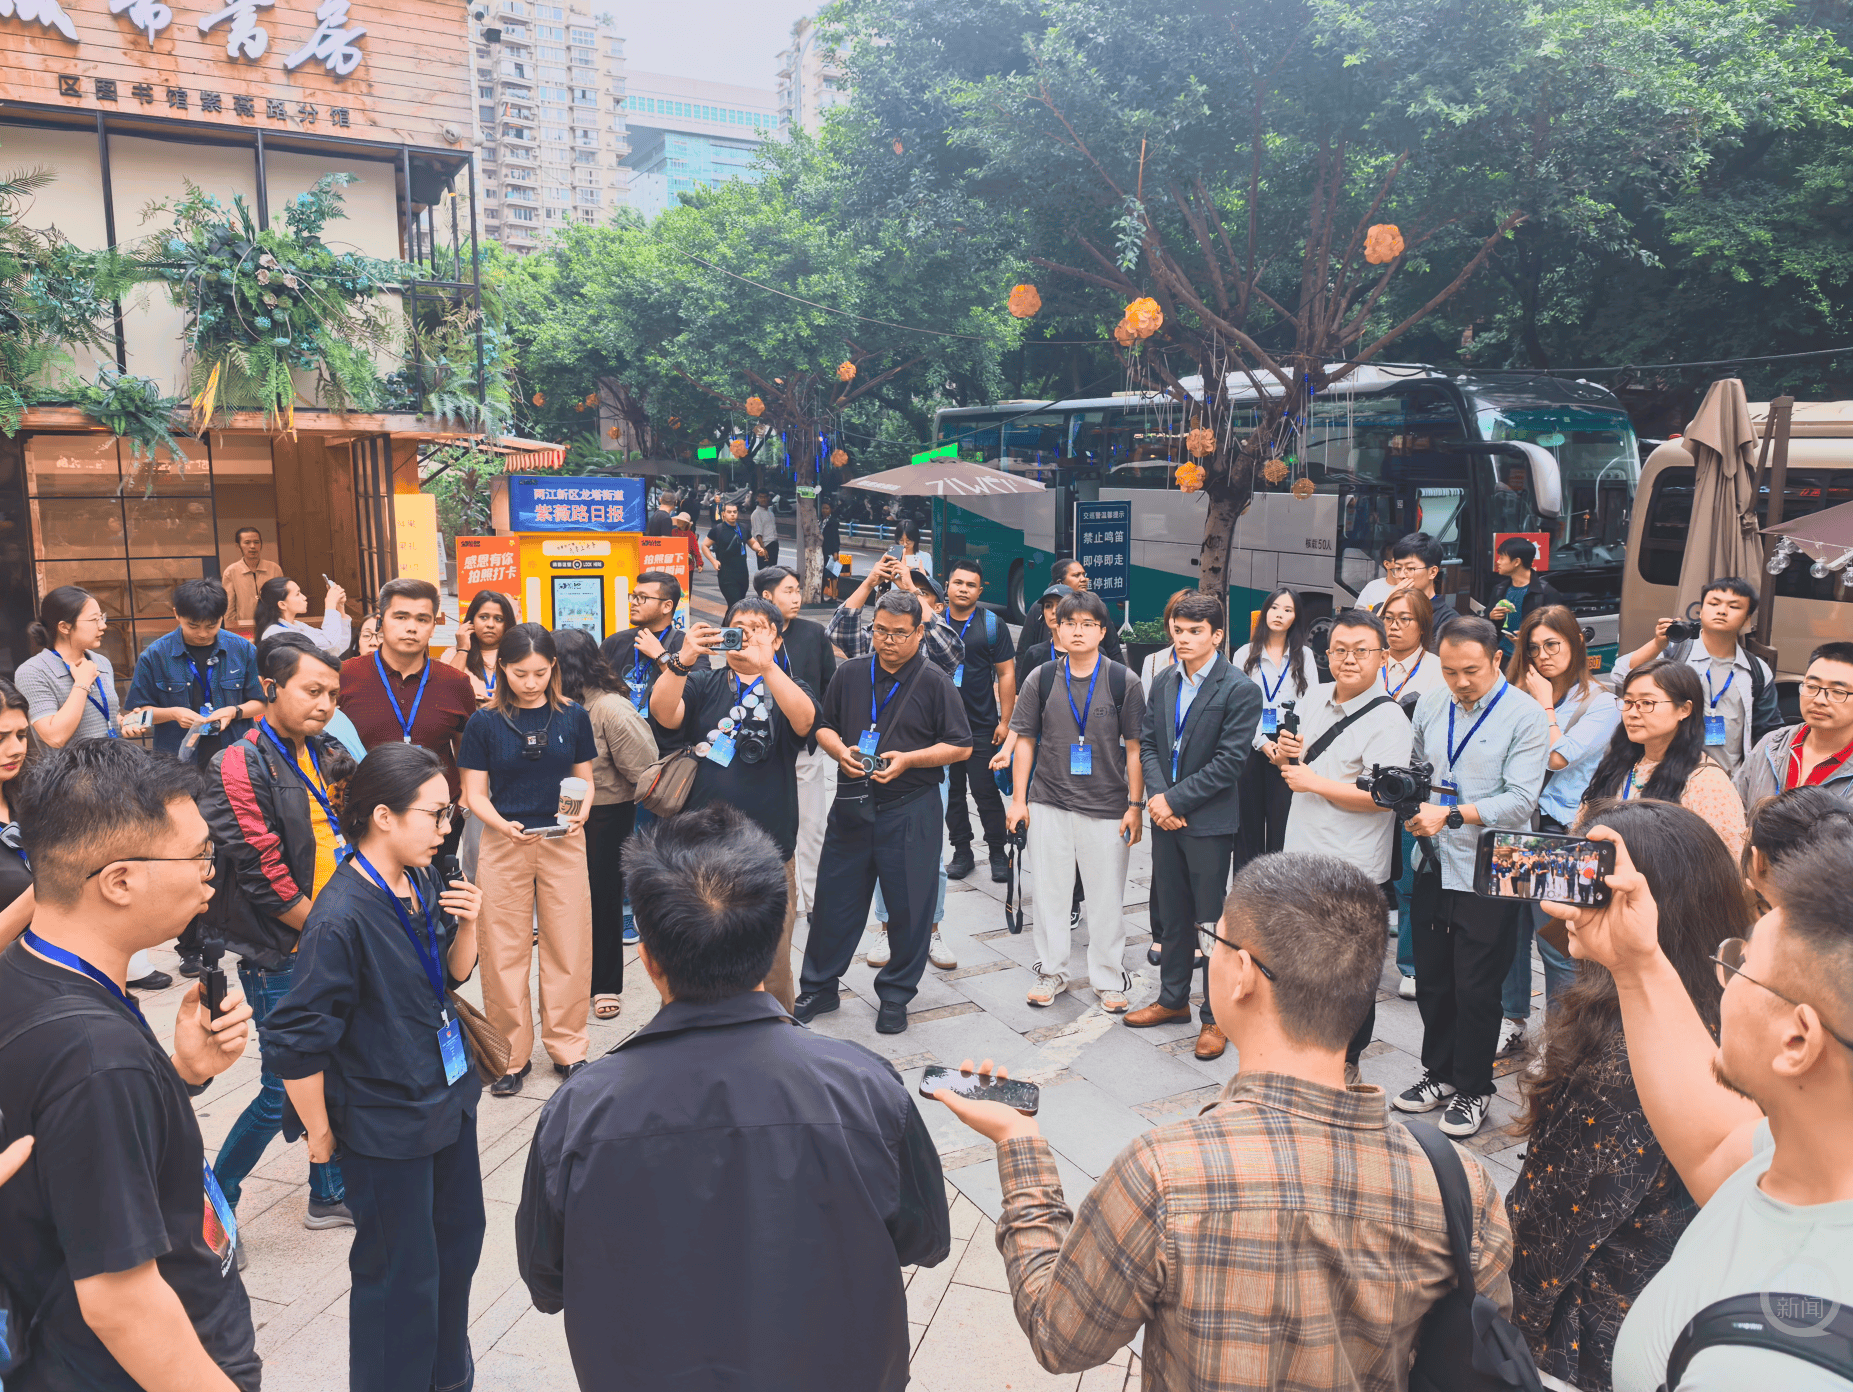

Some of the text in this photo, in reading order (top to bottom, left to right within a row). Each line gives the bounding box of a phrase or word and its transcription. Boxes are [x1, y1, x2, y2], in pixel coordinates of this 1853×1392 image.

[58, 74, 350, 127] 区图书馆紫薇路分馆
[533, 488, 625, 501] 两江新区龙塔街道
[534, 503, 625, 522] 紫薇路日报
[1083, 530, 1125, 545] 禁止鸣笛
[1305, 538, 1332, 550] 核载50人
[463, 551, 514, 570] 感恩有你
[643, 552, 684, 566] 拍照留下
[1083, 553, 1124, 567] 即停即走
[467, 565, 517, 584] 拍照打卡
